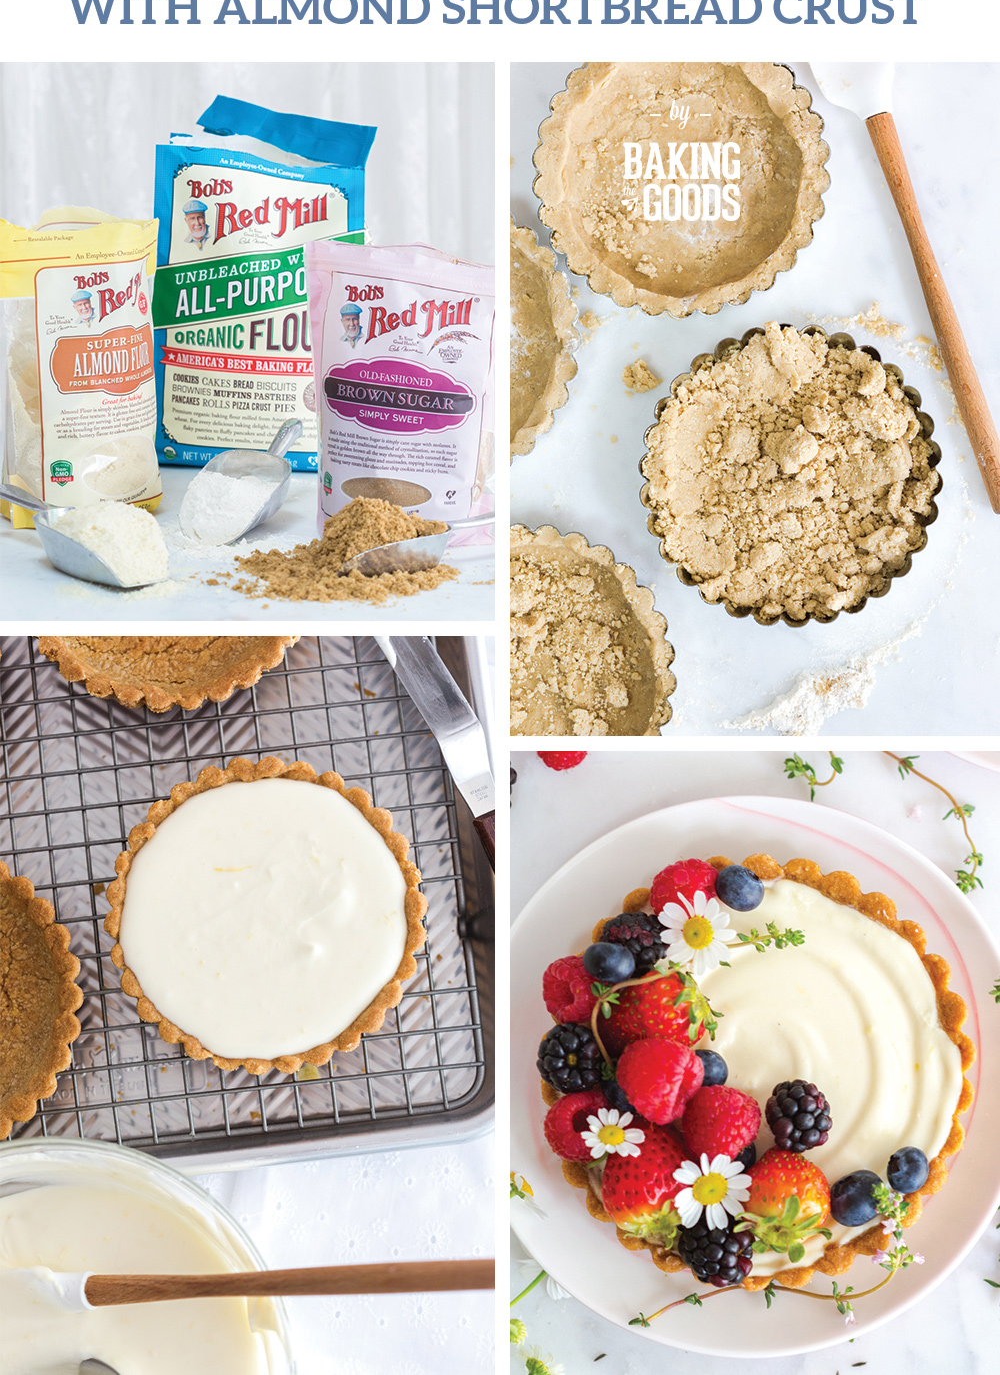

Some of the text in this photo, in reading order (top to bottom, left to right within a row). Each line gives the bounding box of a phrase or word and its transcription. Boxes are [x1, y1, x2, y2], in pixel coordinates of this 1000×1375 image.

[277, 168, 305, 179] Company
[187, 178, 233, 198] Bob's
[213, 193, 328, 245] Red Mill
[73, 271, 110, 290] Bob's
[175, 258, 281, 285] UNBLEACHED
[97, 277, 134, 323] Red
[175, 267, 307, 318] ALL-PURPO
[345, 284, 384, 302] Bob's
[365, 297, 474, 345] Red Mill
[86, 333, 143, 351] SUPER-FINE
[174, 323, 245, 350] ORGANIC
[73, 349, 129, 378] ALMOND
[176, 353, 225, 368] AMERICA'S
[227, 358, 253, 371] BEST
[255, 360, 294, 373] BAKING
[90, 377, 124, 386] BLANCHED
[173, 373, 297, 392] COOKIES CAKES BREAD BISCUITS
[359, 370, 433, 387] OLD-FASHIONED
[172, 384, 297, 402] BROWNIES MUFFINS PASTRIES
[337, 384, 454, 410] BROWN SUGAR
[171, 394, 296, 412] PANCAKES ROLLS PIZZA CRUST PIES
[359, 409, 424, 425] SIMPLY SWEET
[183, 451, 198, 461] NET
